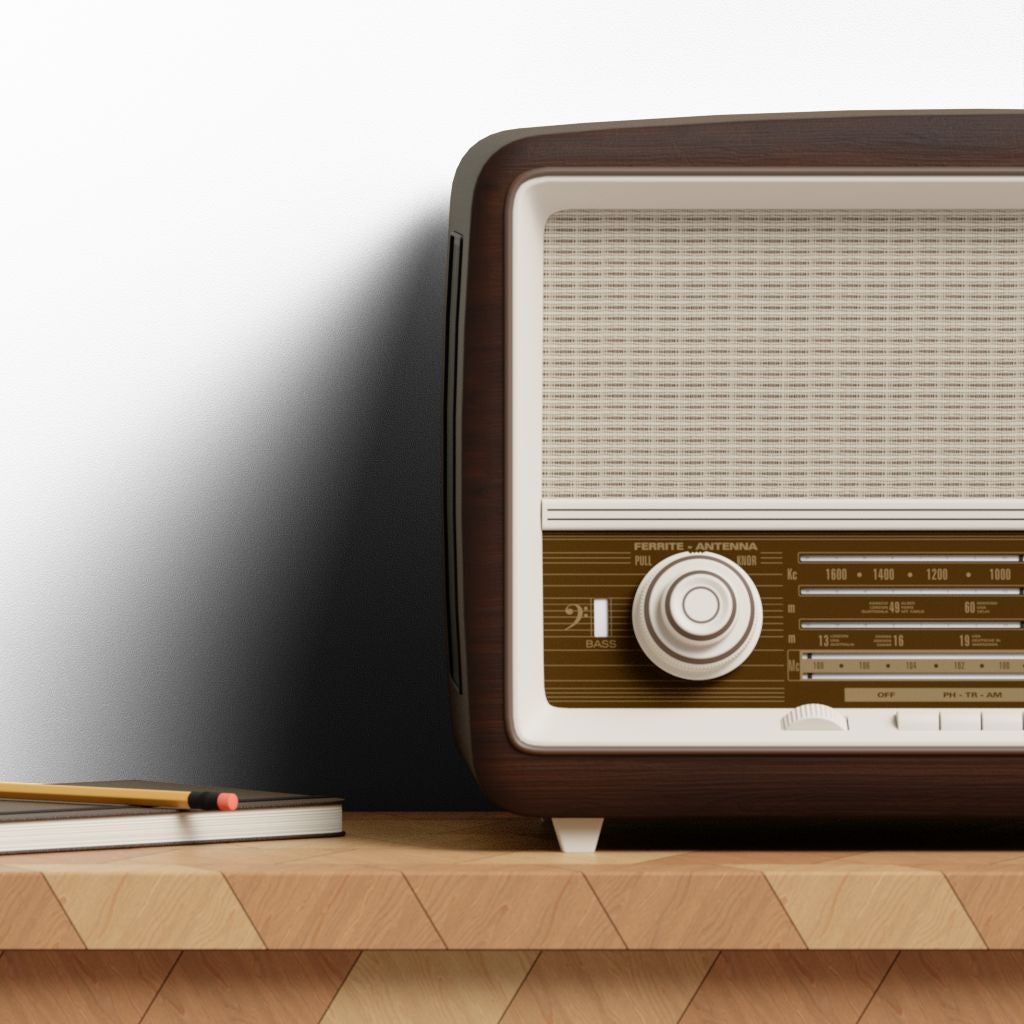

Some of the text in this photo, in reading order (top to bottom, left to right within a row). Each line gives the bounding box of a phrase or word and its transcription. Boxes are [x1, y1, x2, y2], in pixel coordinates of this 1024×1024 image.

[634, 542, 684, 551] FERRITE
[695, 542, 758, 551] ANTENNA
[634, 555, 653, 566] PULL
[787, 568, 1012, 581] Kc 1600 1400 1200 1000
[787, 603, 796, 614] m
[888, 602, 900, 614] 49
[964, 602, 976, 614] 60
[585, 640, 617, 649] BASS
[787, 634, 796, 644] m
[818, 634, 829, 647] 13
[893, 634, 904, 647] 16
[959, 634, 970, 647] 19
